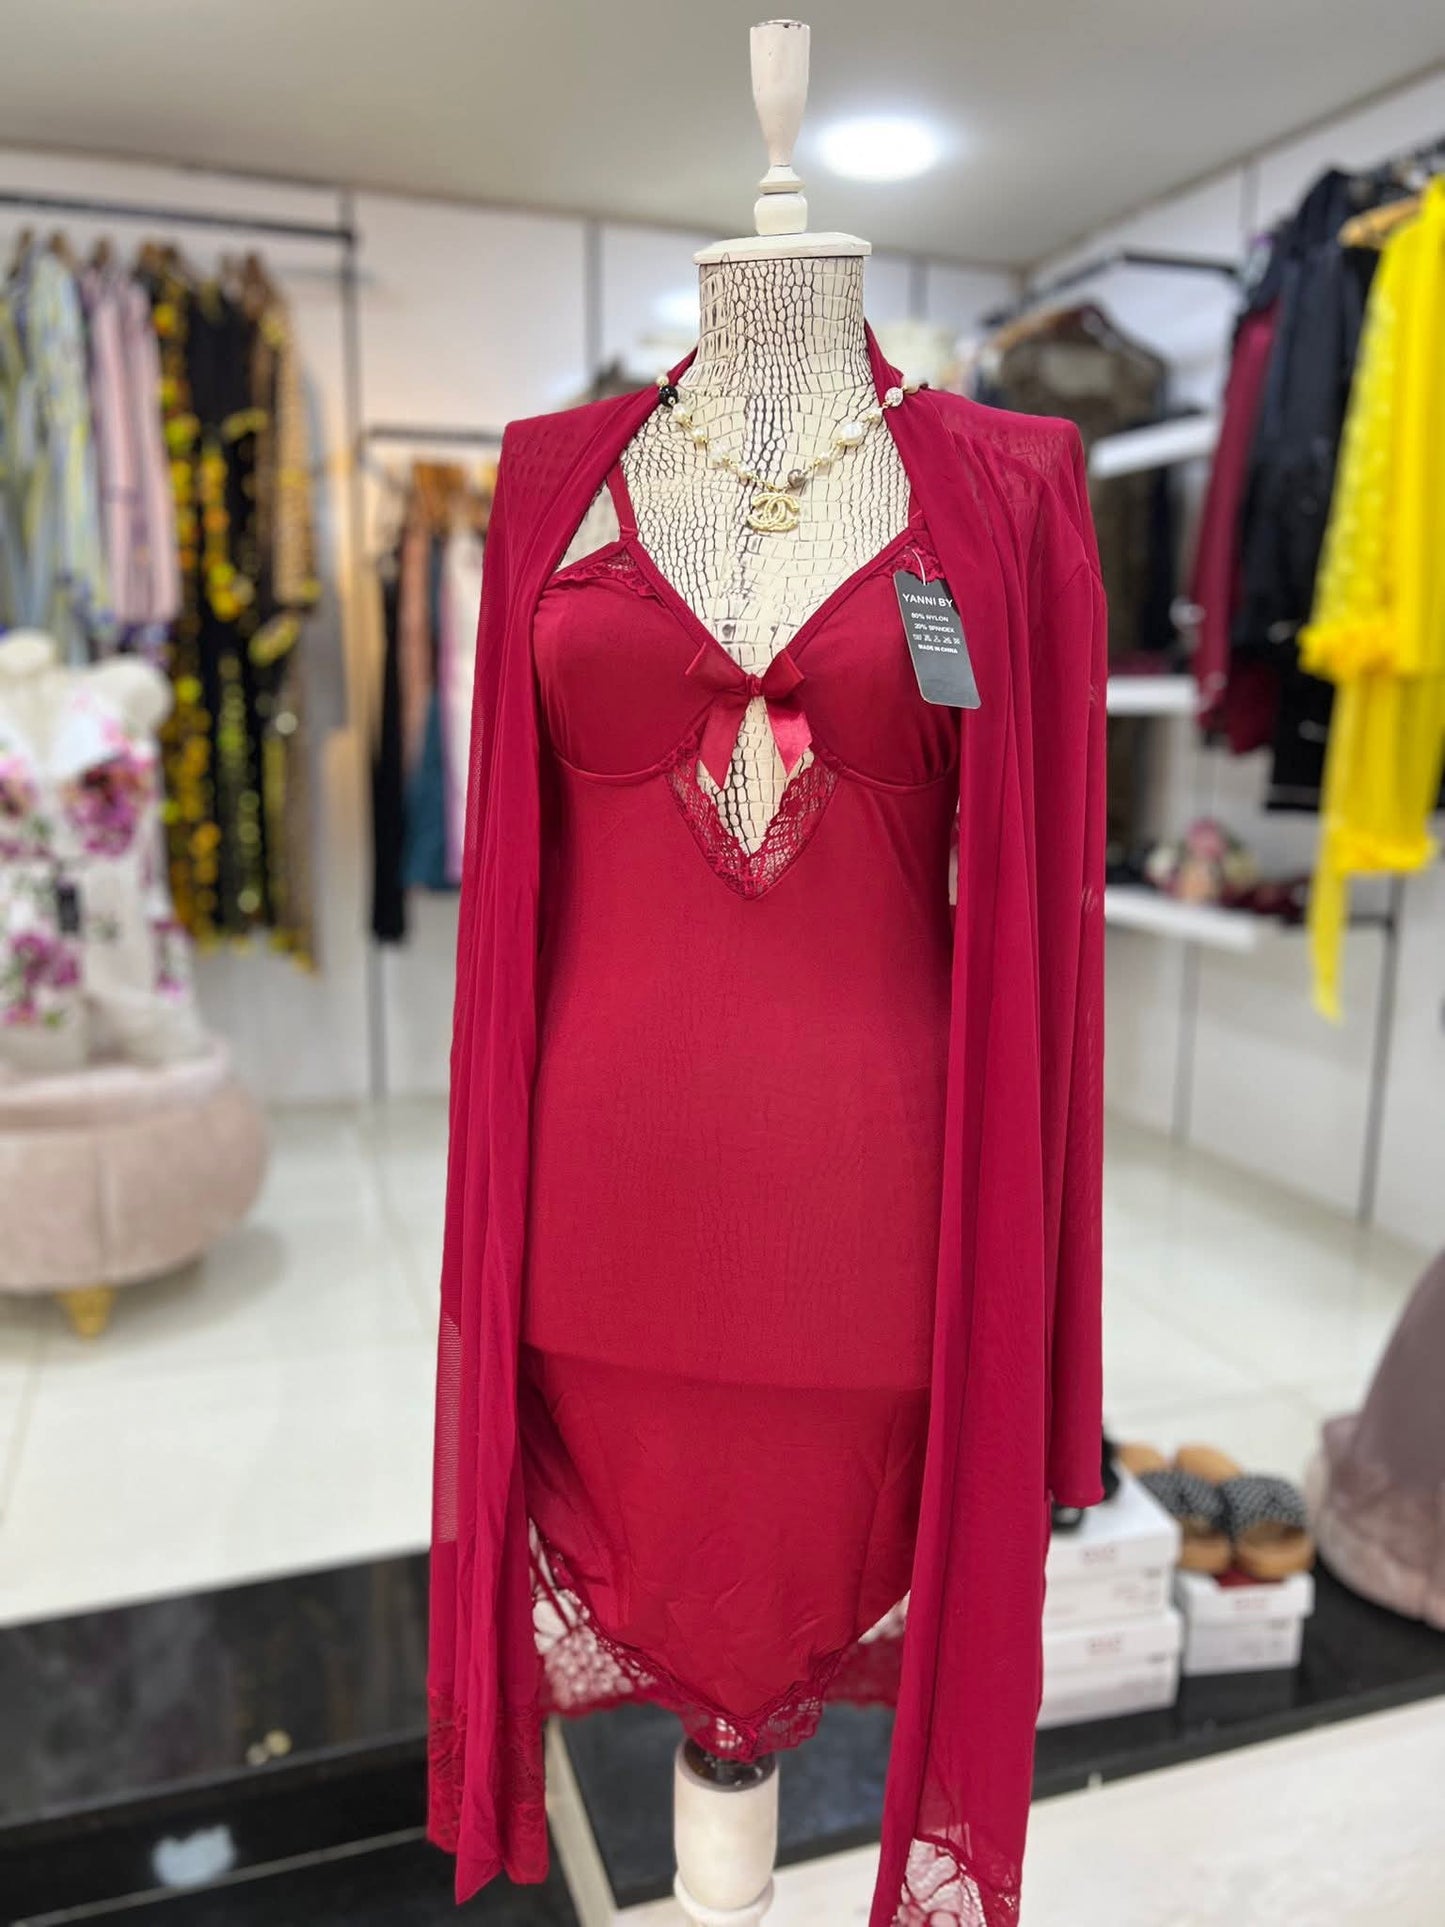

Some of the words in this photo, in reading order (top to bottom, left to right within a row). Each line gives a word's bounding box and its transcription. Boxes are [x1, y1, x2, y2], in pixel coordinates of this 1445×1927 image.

[902, 593, 936, 606] YANNI
[938, 598, 953, 608] BY
[926, 614, 949, 622] NYLON
[914, 622, 928, 630] 20%
[928, 625, 955, 633] SPANDEX
[918, 644, 934, 652] MADE
[940, 646, 958, 654] CHINA
